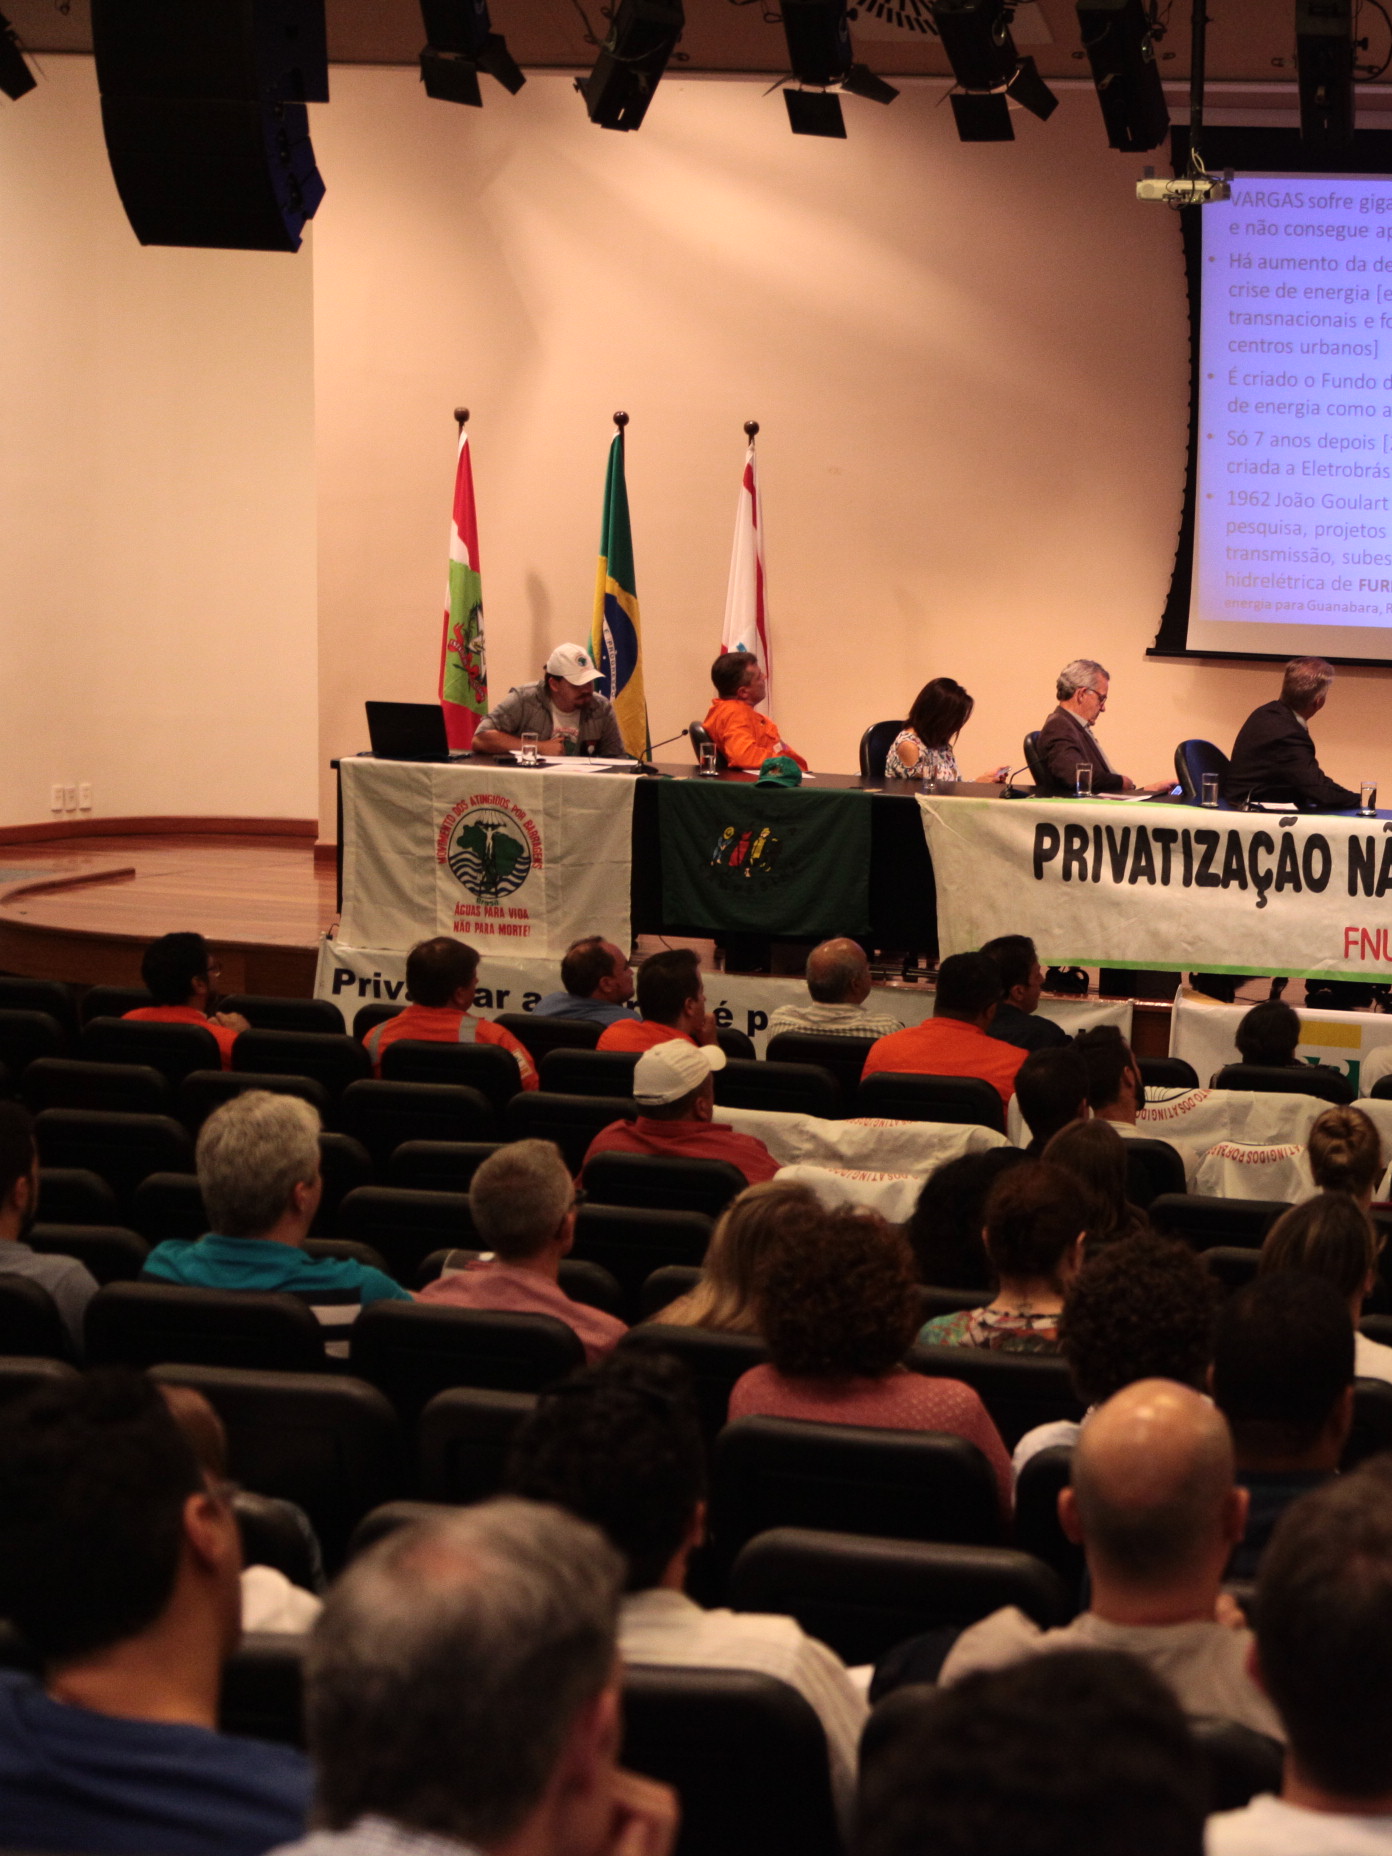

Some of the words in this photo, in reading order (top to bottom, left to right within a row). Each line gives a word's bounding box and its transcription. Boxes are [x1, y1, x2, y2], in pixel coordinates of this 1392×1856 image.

[1228, 187, 1304, 208] VARGAS
[1308, 191, 1353, 209] sofre
[1228, 222, 1239, 235] e
[1245, 219, 1278, 236] não
[1283, 224, 1368, 241] consegue
[1229, 252, 1252, 269] Há
[1257, 255, 1338, 271] aumento
[1345, 255, 1366, 272] da
[1228, 281, 1270, 298] crise
[1275, 282, 1297, 299] de
[1303, 283, 1369, 304] energia
[1228, 309, 1357, 328] transnacionais
[1363, 316, 1374, 328] e
[1228, 337, 1293, 354] centros
[1300, 337, 1378, 360] urbanos]
[1228, 366, 1237, 385] É
[1242, 369, 1298, 387] criado
[1304, 375, 1315, 388] o
[1321, 371, 1377, 389] Fundo
[1227, 396, 1249, 413] de
[1254, 397, 1320, 419] energia
[1326, 403, 1376, 417] como
[1382, 405, 1392, 417] a
[1227, 429, 1248, 446] Só
[1253, 430, 1264, 446] 7
[1270, 435, 1311, 448] anos
[1317, 432, 1375, 453] depois
[1227, 457, 1280, 475] criada
[1285, 463, 1295, 475] a
[1301, 459, 1391, 478] Eletrobrás
[1228, 489, 1270, 506] 1962
[1274, 491, 1315, 508] João
[1321, 492, 1389, 511] Goulart
[1226, 517, 1307, 539] pesquisa,
[1314, 521, 1386, 542] projetos
[1225, 544, 1335, 565] transmissão,
[1225, 569, 1324, 590] hidrelétrica
[1331, 575, 1352, 591] de
[1224, 598, 1271, 612] energia
[1275, 600, 1304, 612] para
[1306, 599, 1382, 615] Guanabara,
[436, 814, 456, 864] MOVIMENTO
[452, 800, 468, 817] DOS
[470, 794, 511, 810] ATINGIDOS
[511, 804, 527, 821] POR
[523, 819, 543, 869] BARRAGENS
[1033, 816, 1332, 909] PRIVATIZAÇÃO
[454, 901, 481, 917] ÁGUAS
[484, 905, 505, 918] PARA
[508, 907, 530, 920] VIDA
[453, 919, 471, 933] NÃO
[474, 922, 495, 935] PARA
[498, 924, 531, 937] MORTE!
